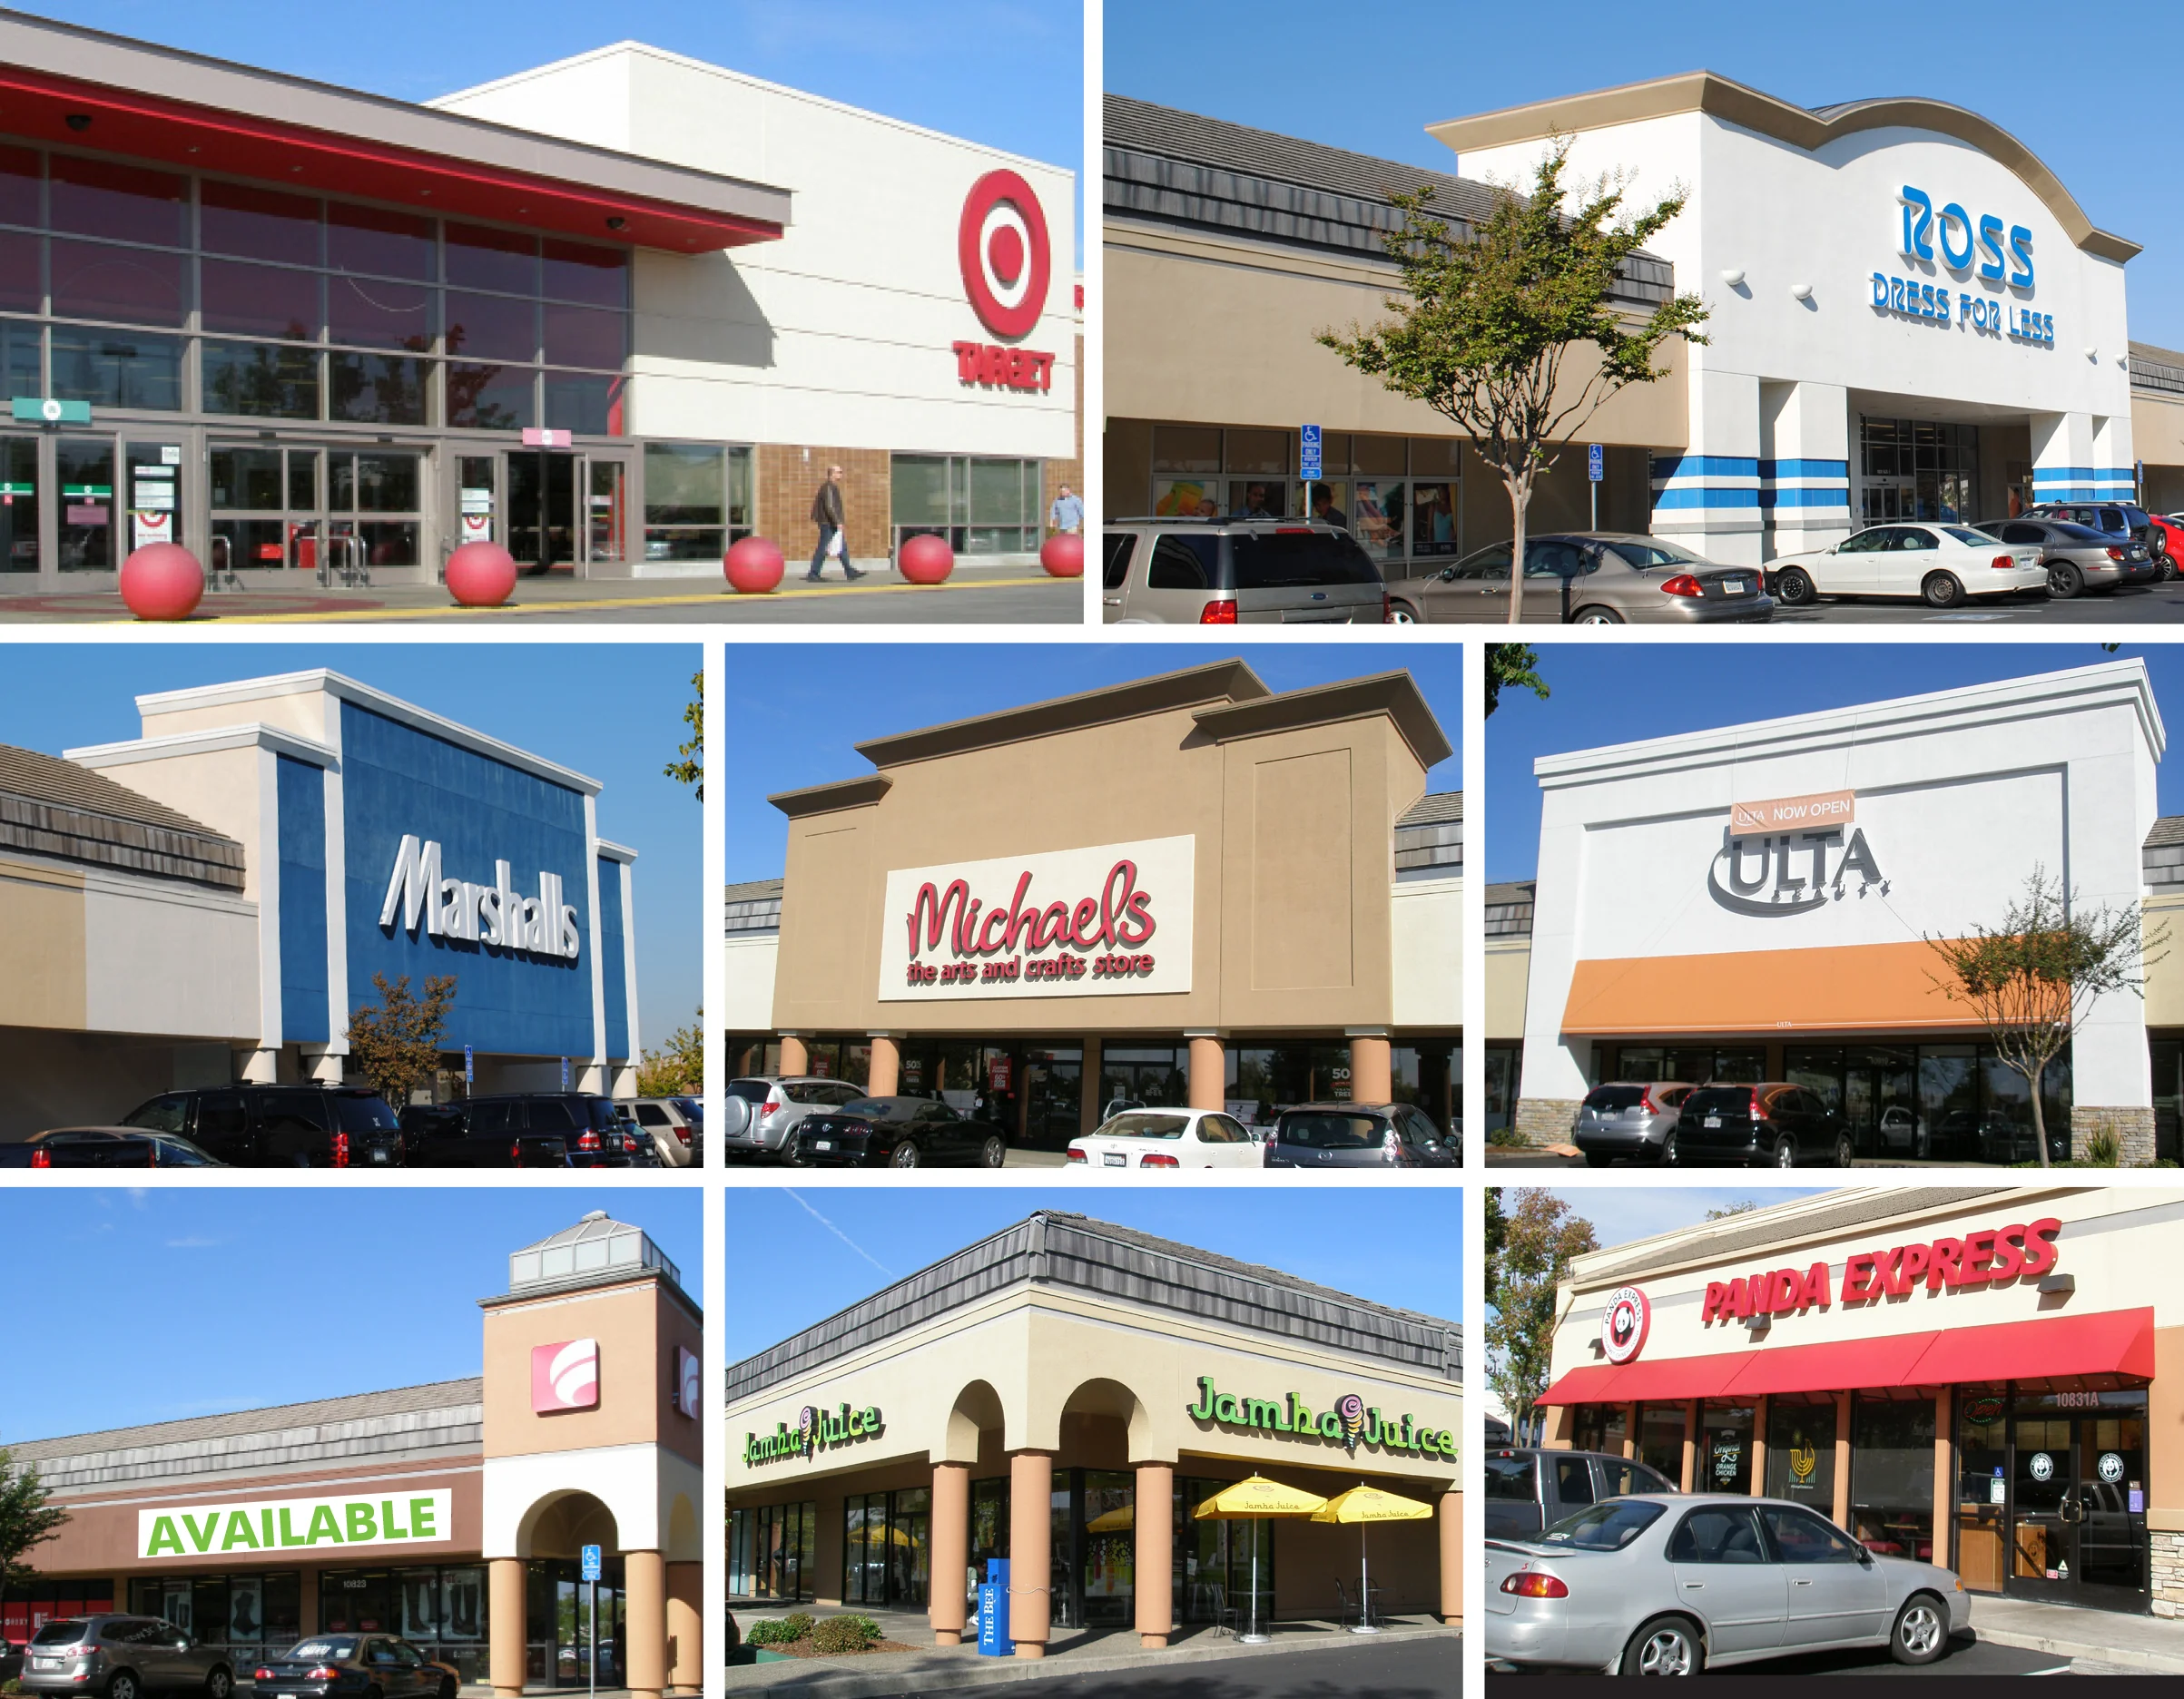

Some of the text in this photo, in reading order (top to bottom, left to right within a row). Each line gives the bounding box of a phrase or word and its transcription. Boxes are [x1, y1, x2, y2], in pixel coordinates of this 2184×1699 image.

[1898, 185, 2034, 289] ROSS
[1871, 272, 2054, 342] DRESS FOR LESS
[951, 340, 1056, 390] TARGET
[1737, 799, 1851, 823] ULTA NOW OPEN
[1729, 828, 1883, 897] ULTA
[379, 834, 580, 959] Marshalls
[908, 859, 1155, 956] Michaels
[908, 952, 1154, 981] the arts and crafts store
[1702, 1218, 2061, 1322] PANDA EXPRESS
[1605, 1290, 1641, 1324] PANDA EXPRESS
[1186, 1376, 1459, 1455] Jamba Juice
[1963, 1401, 2004, 1419] Open
[2055, 1391, 2100, 1408] 10831A
[742, 1402, 880, 1463] Jamba Juice
[1714, 1441, 1741, 1462] Original
[146, 1498, 437, 1557] AVAILABLE
[1244, 1500, 1300, 1510] Jamba Juice
[1362, 1511, 1386, 1519] Jamba
[343, 1579, 367, 1589] 10823
[983, 1588, 994, 1646] THE BEE
